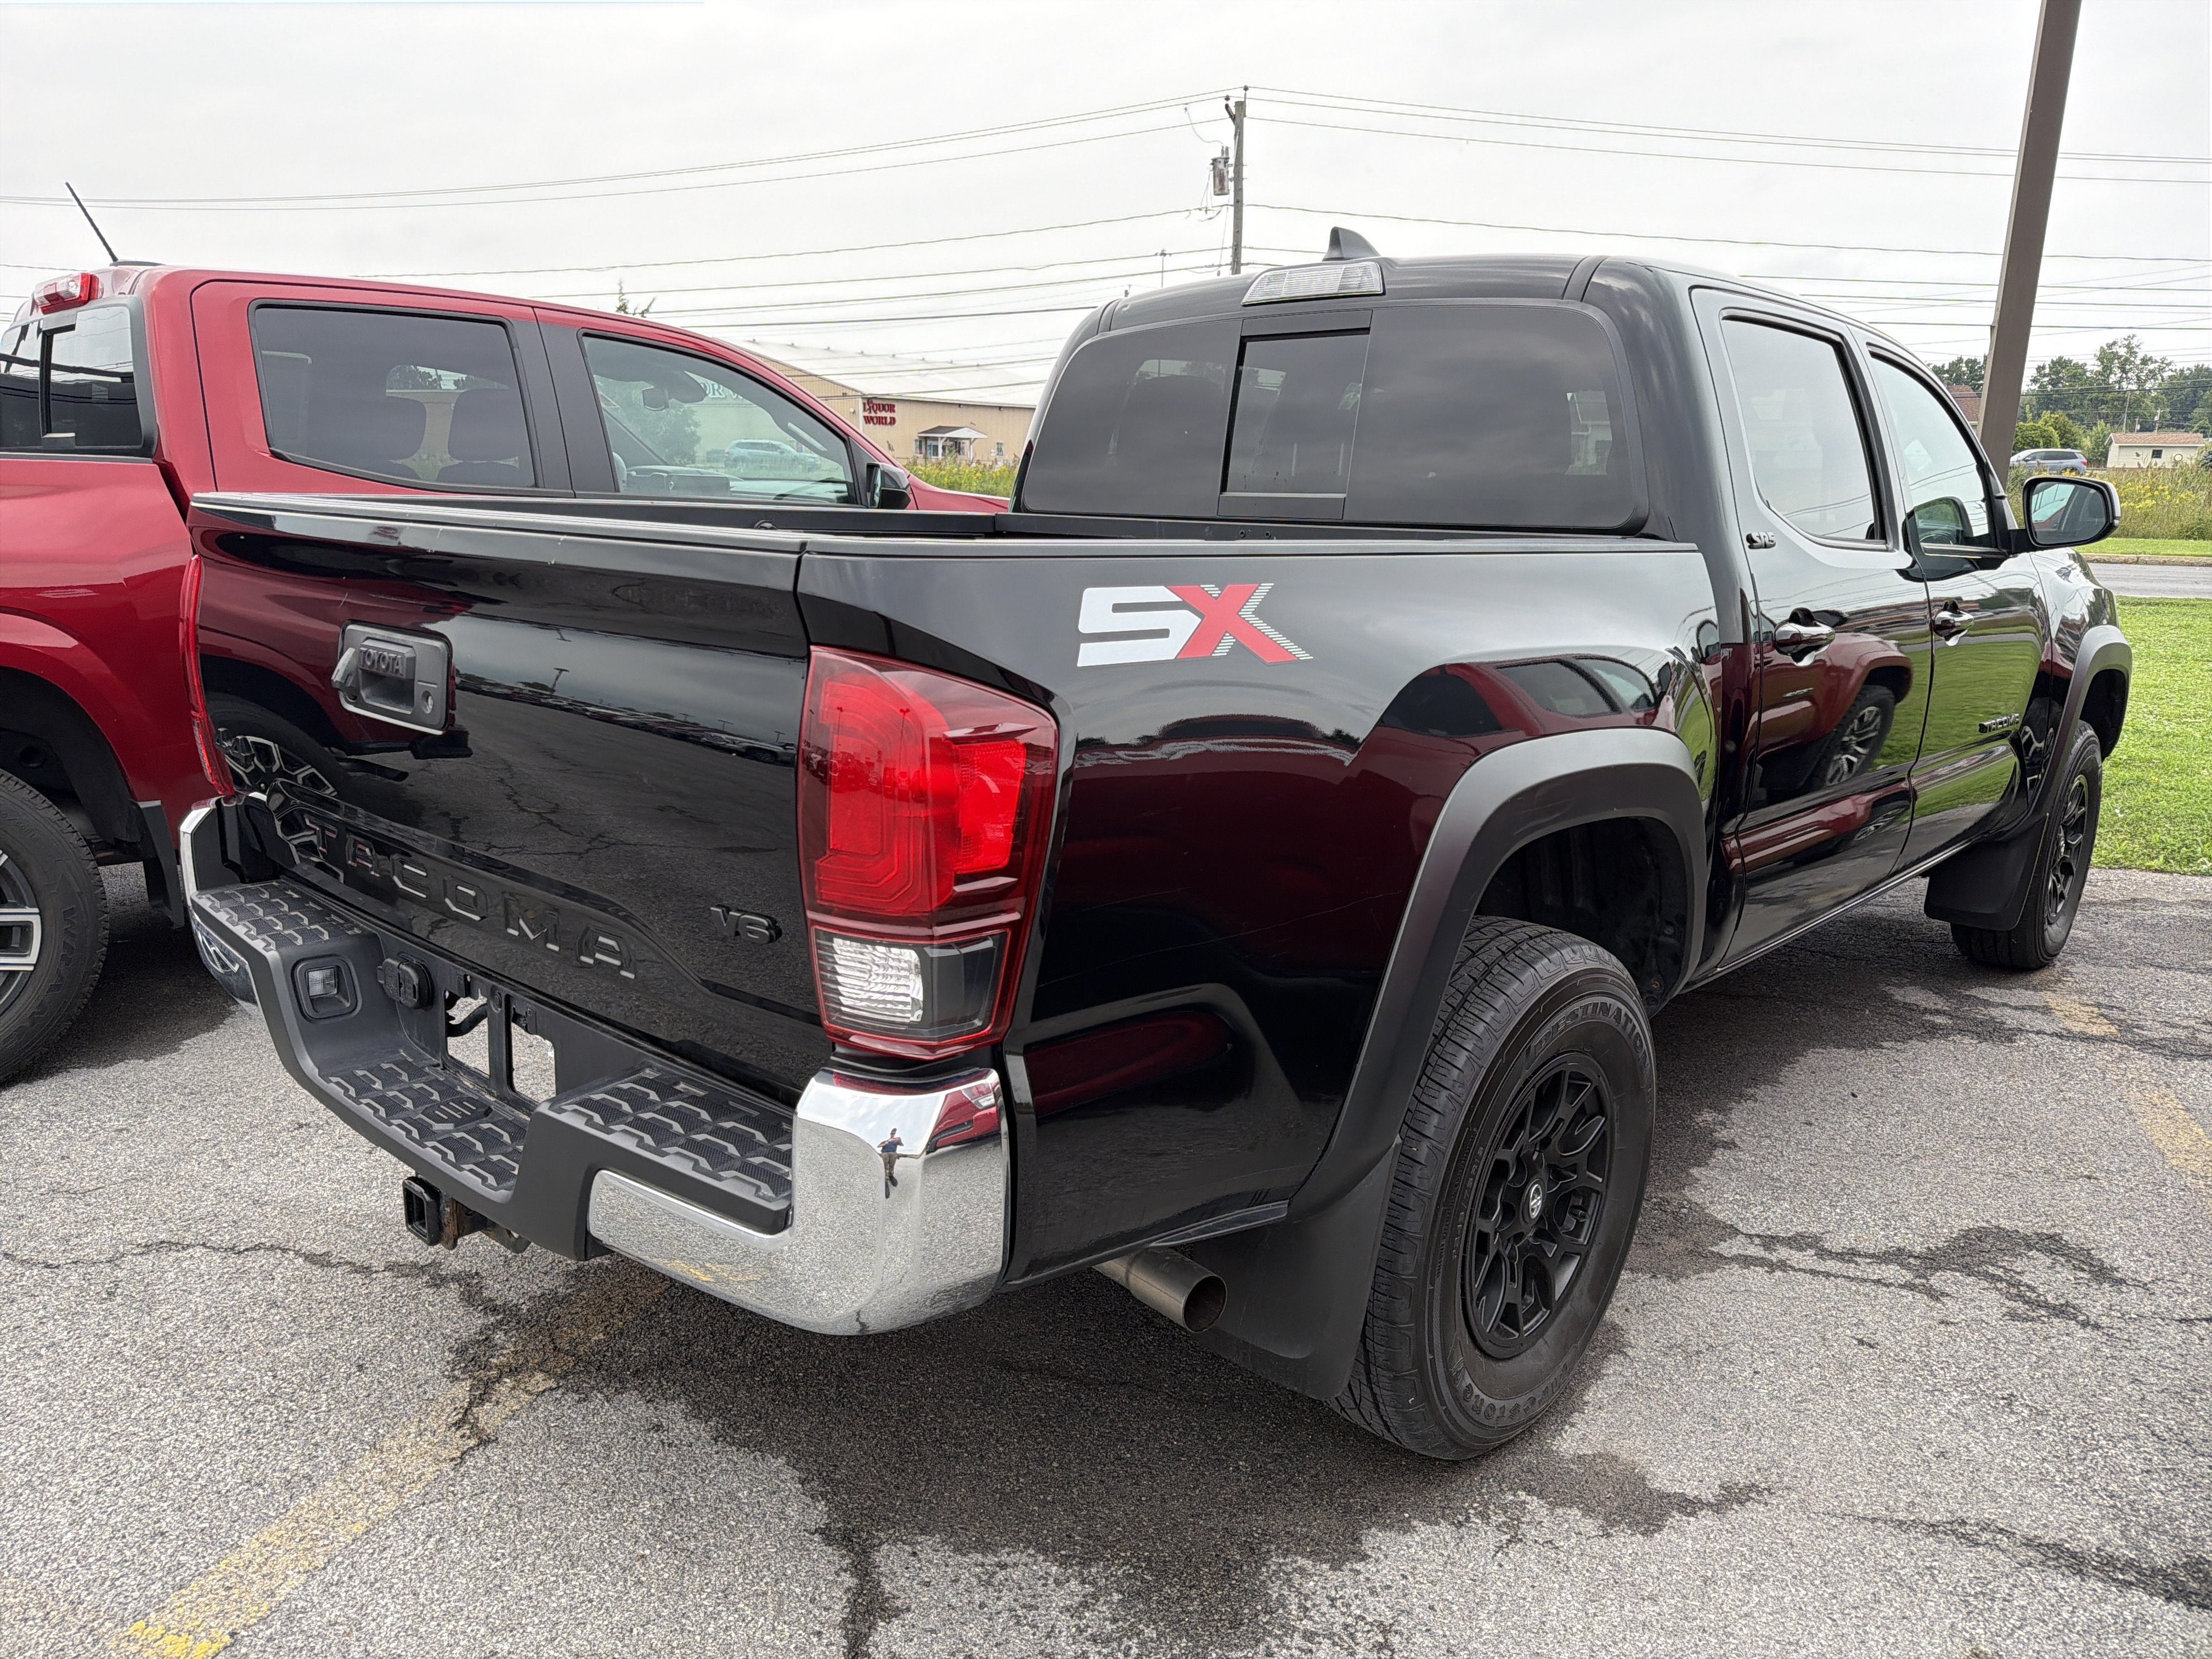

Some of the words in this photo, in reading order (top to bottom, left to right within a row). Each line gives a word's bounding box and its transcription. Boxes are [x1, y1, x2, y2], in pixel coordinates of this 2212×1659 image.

[862, 398, 896, 414] LIQUOR
[863, 415, 896, 426] WORLD
[1747, 532, 1776, 549] SR5
[1076, 583, 1312, 667] SX
[359, 647, 404, 676] TOYOTA
[303, 815, 636, 980] TACOMA
[709, 906, 775, 944] V6
[1534, 1001, 1649, 1069] DESTINATION
